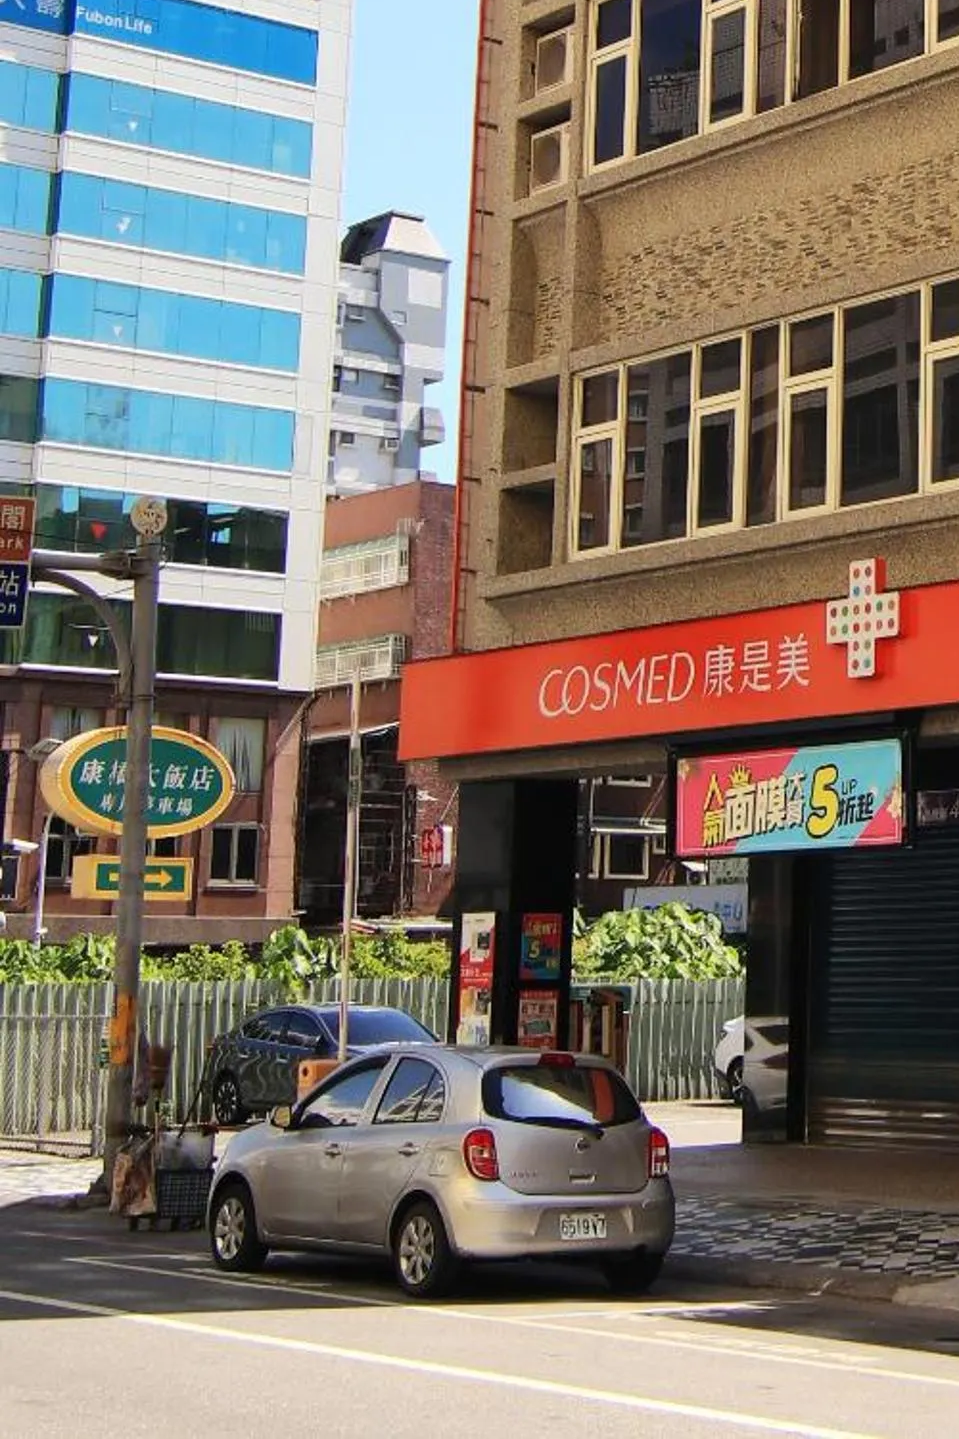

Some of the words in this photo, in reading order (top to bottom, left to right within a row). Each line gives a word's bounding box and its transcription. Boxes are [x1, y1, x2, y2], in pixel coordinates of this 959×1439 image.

[76, 5, 123, 28] Fubon
[124, 17, 153, 35] Life
[539, 652, 695, 717] COSMED
[704, 633, 811, 697] 康是美
